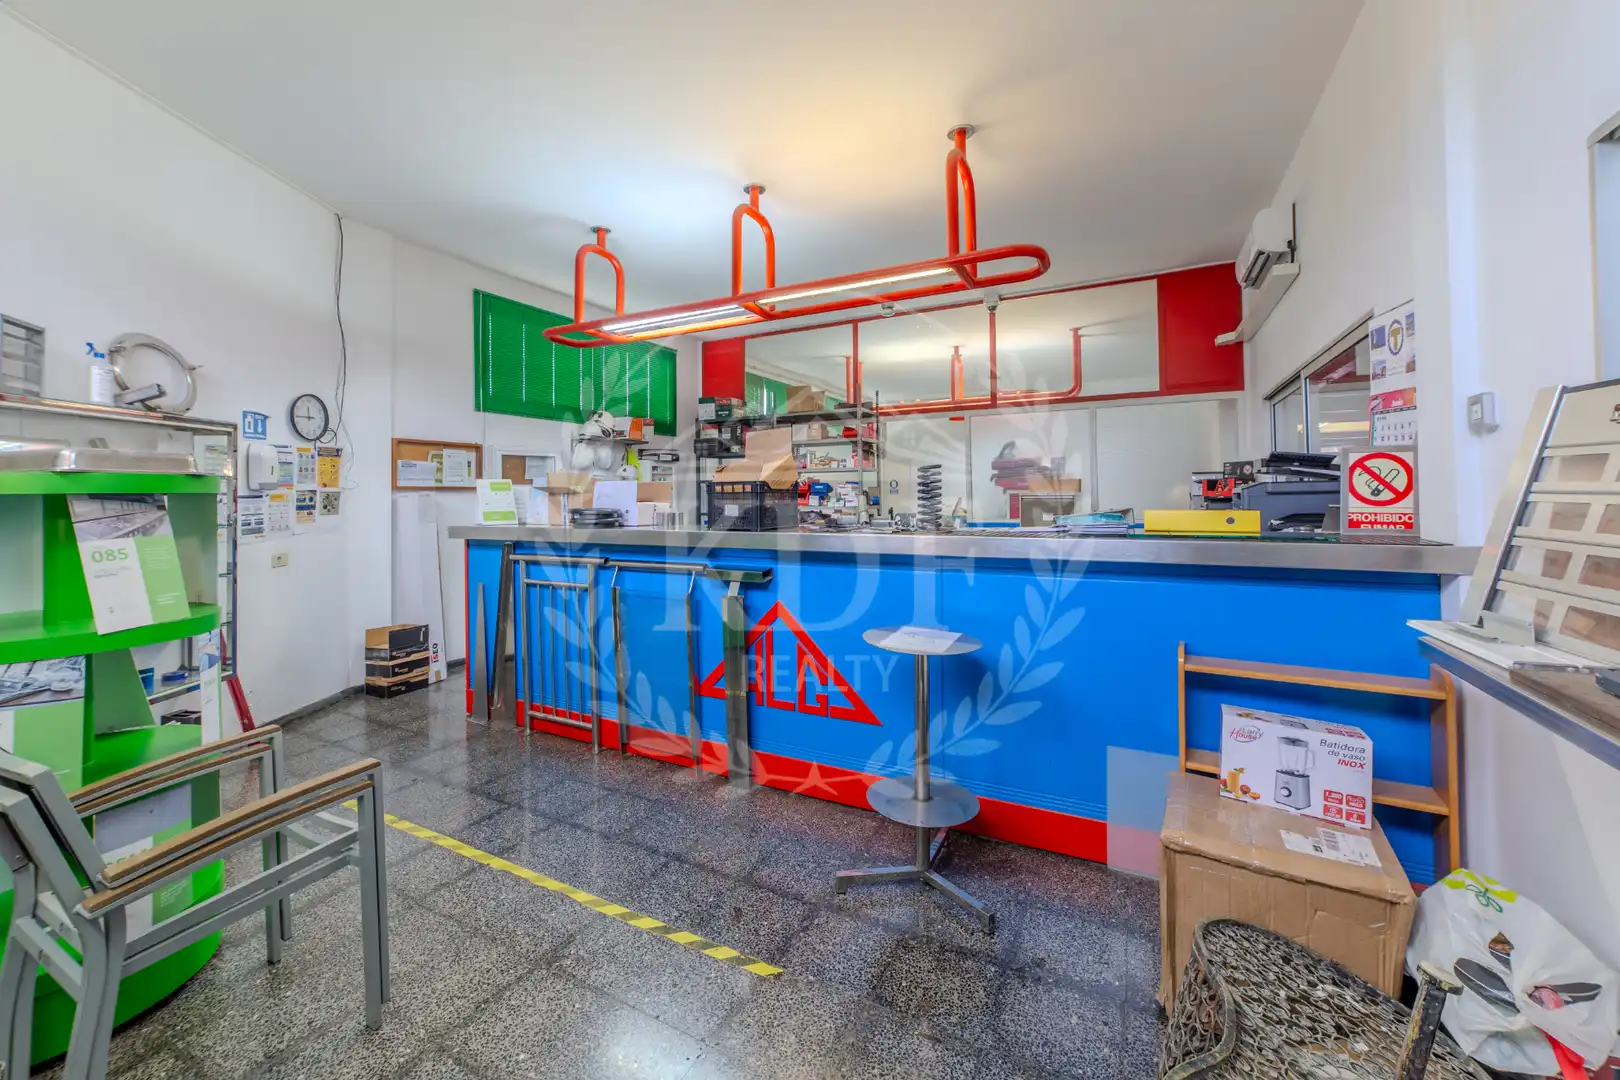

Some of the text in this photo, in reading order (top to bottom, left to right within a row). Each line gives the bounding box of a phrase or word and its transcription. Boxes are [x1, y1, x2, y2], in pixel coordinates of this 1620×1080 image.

[1348, 513, 1414, 523] PROHIBIDO
[91, 547, 129, 563] 085
[1229, 727, 1258, 740] House
[1319, 739, 1366, 753] Batidora
[1327, 749, 1366, 762] de vaso
[1337, 758, 1367, 770] INOX
